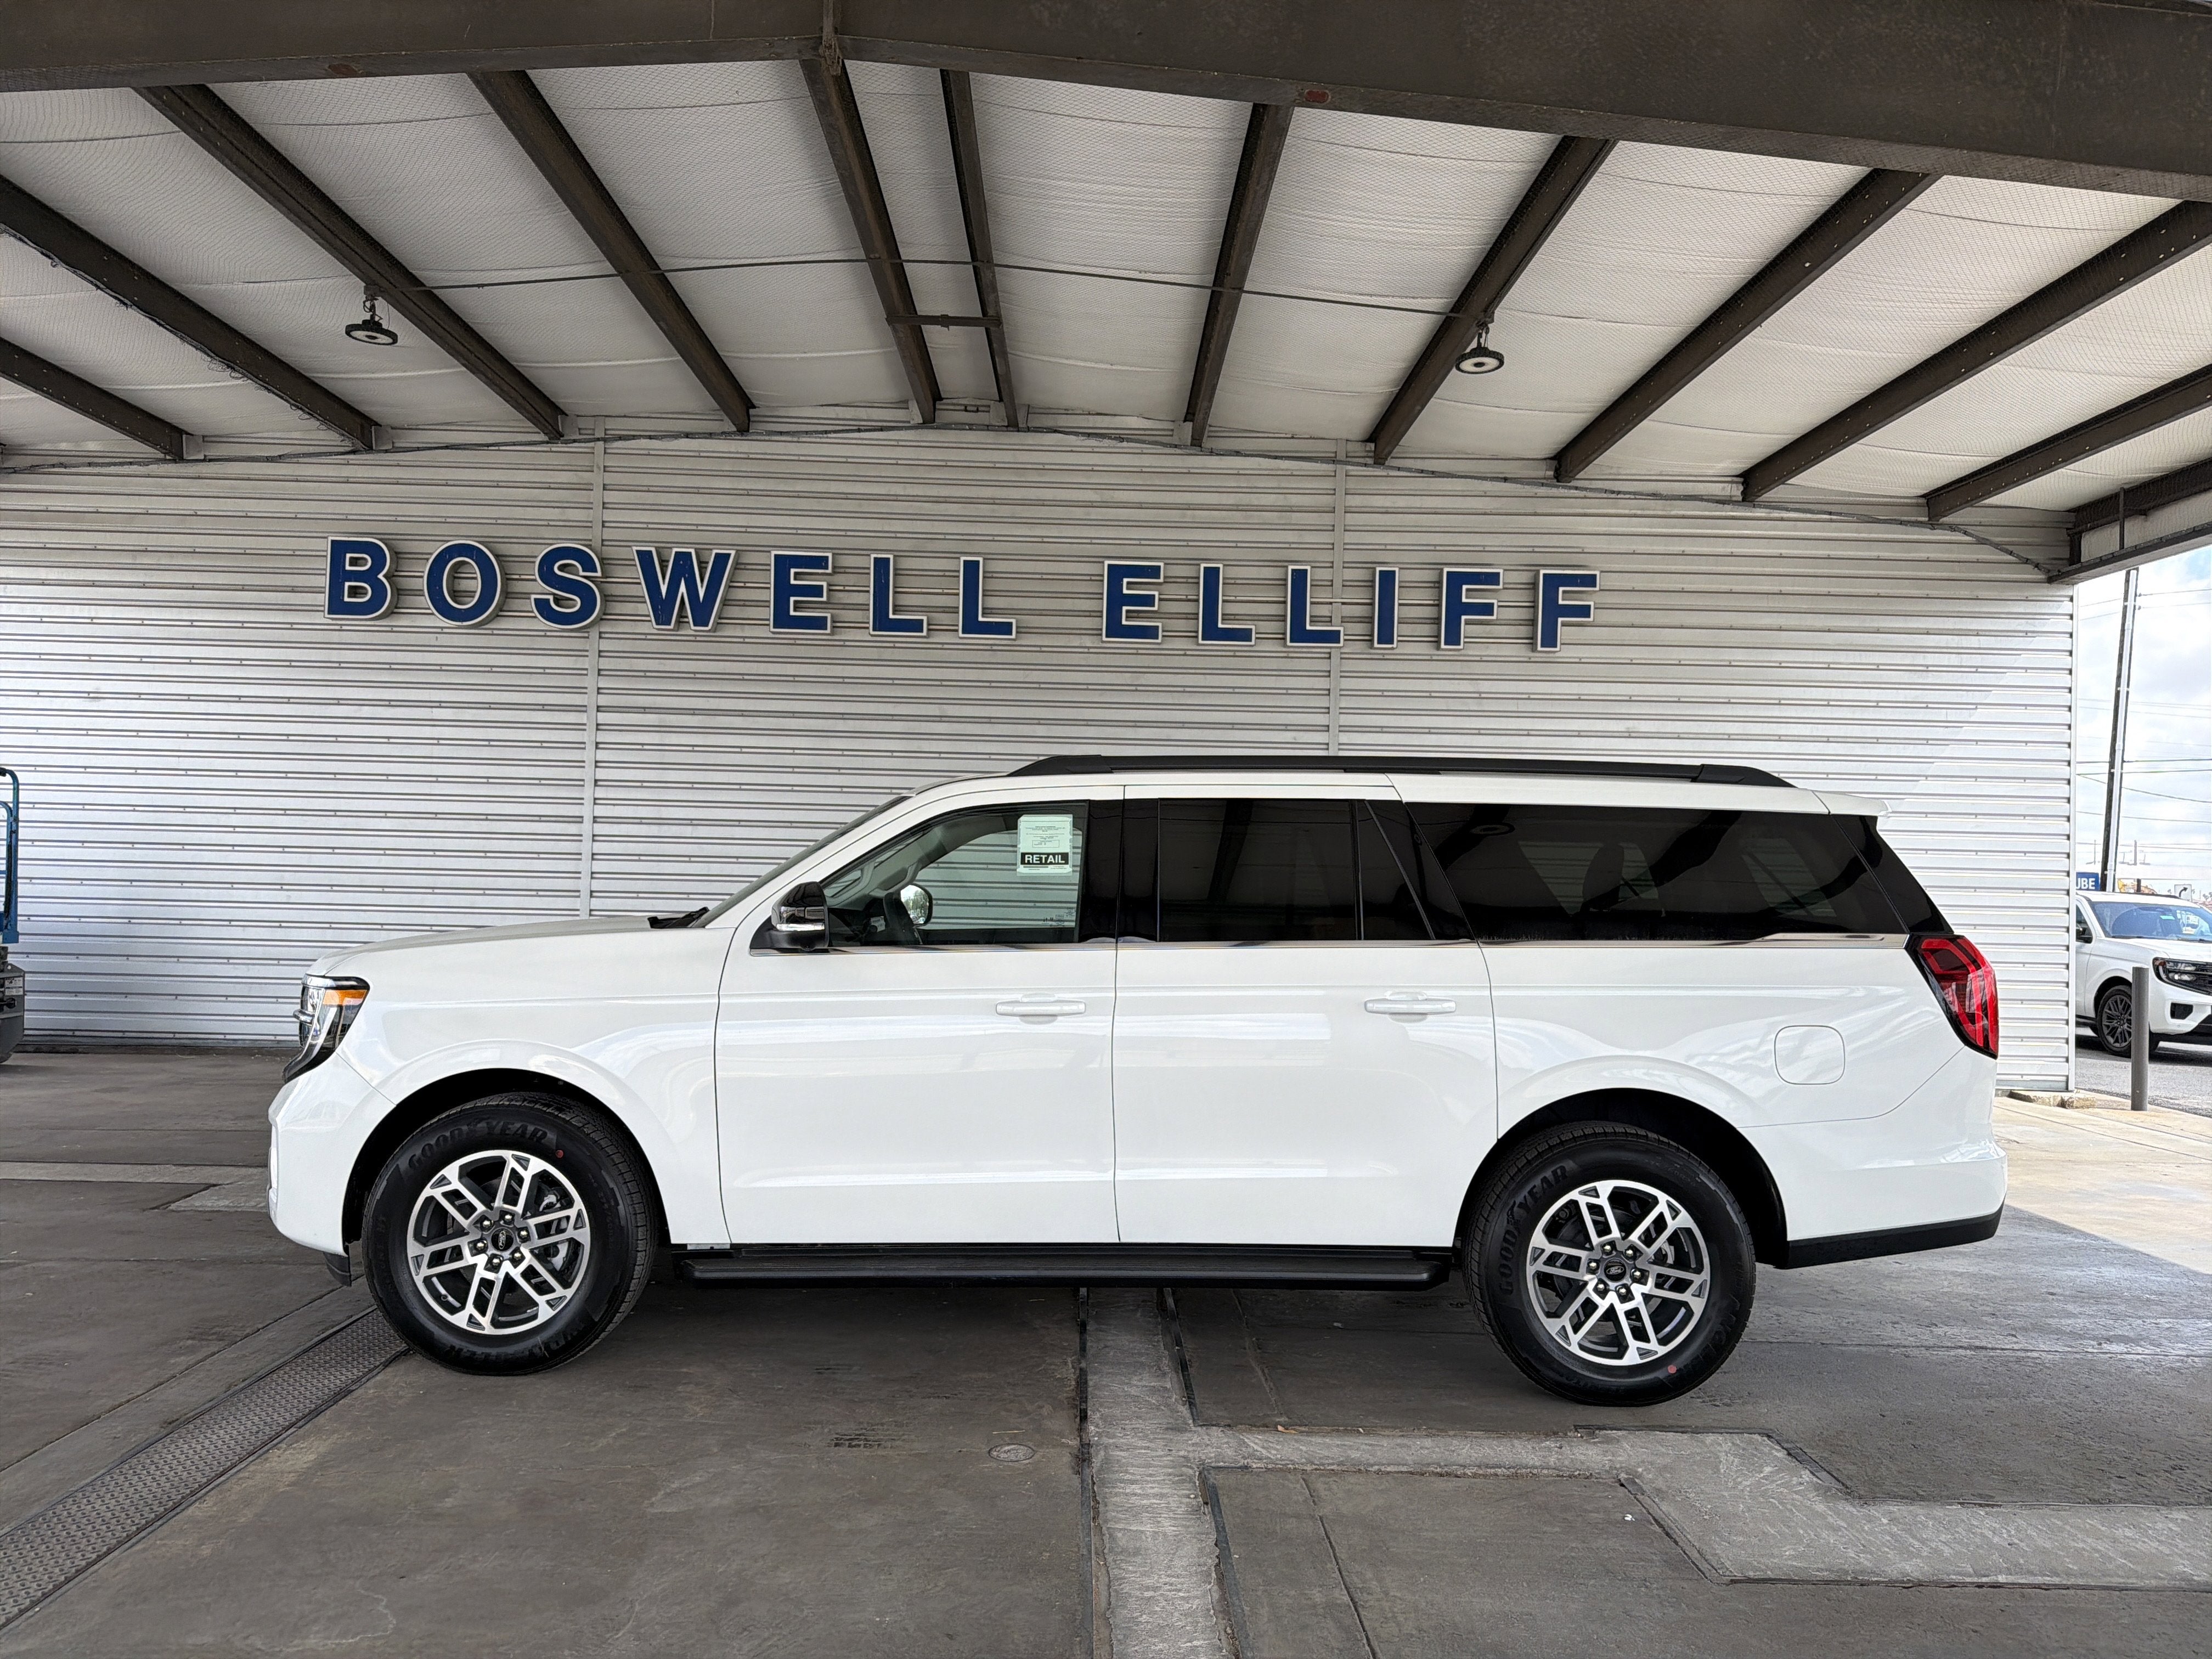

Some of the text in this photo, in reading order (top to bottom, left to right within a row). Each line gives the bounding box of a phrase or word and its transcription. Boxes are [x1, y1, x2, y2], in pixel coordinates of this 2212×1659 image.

[324, 536, 1600, 651] BOSWELL ELLIFF
[1025, 854, 1065, 864] RETAIL
[408, 1118, 548, 1170] GOODYEAR
[1497, 1164, 1569, 1295] GOODYEAR
